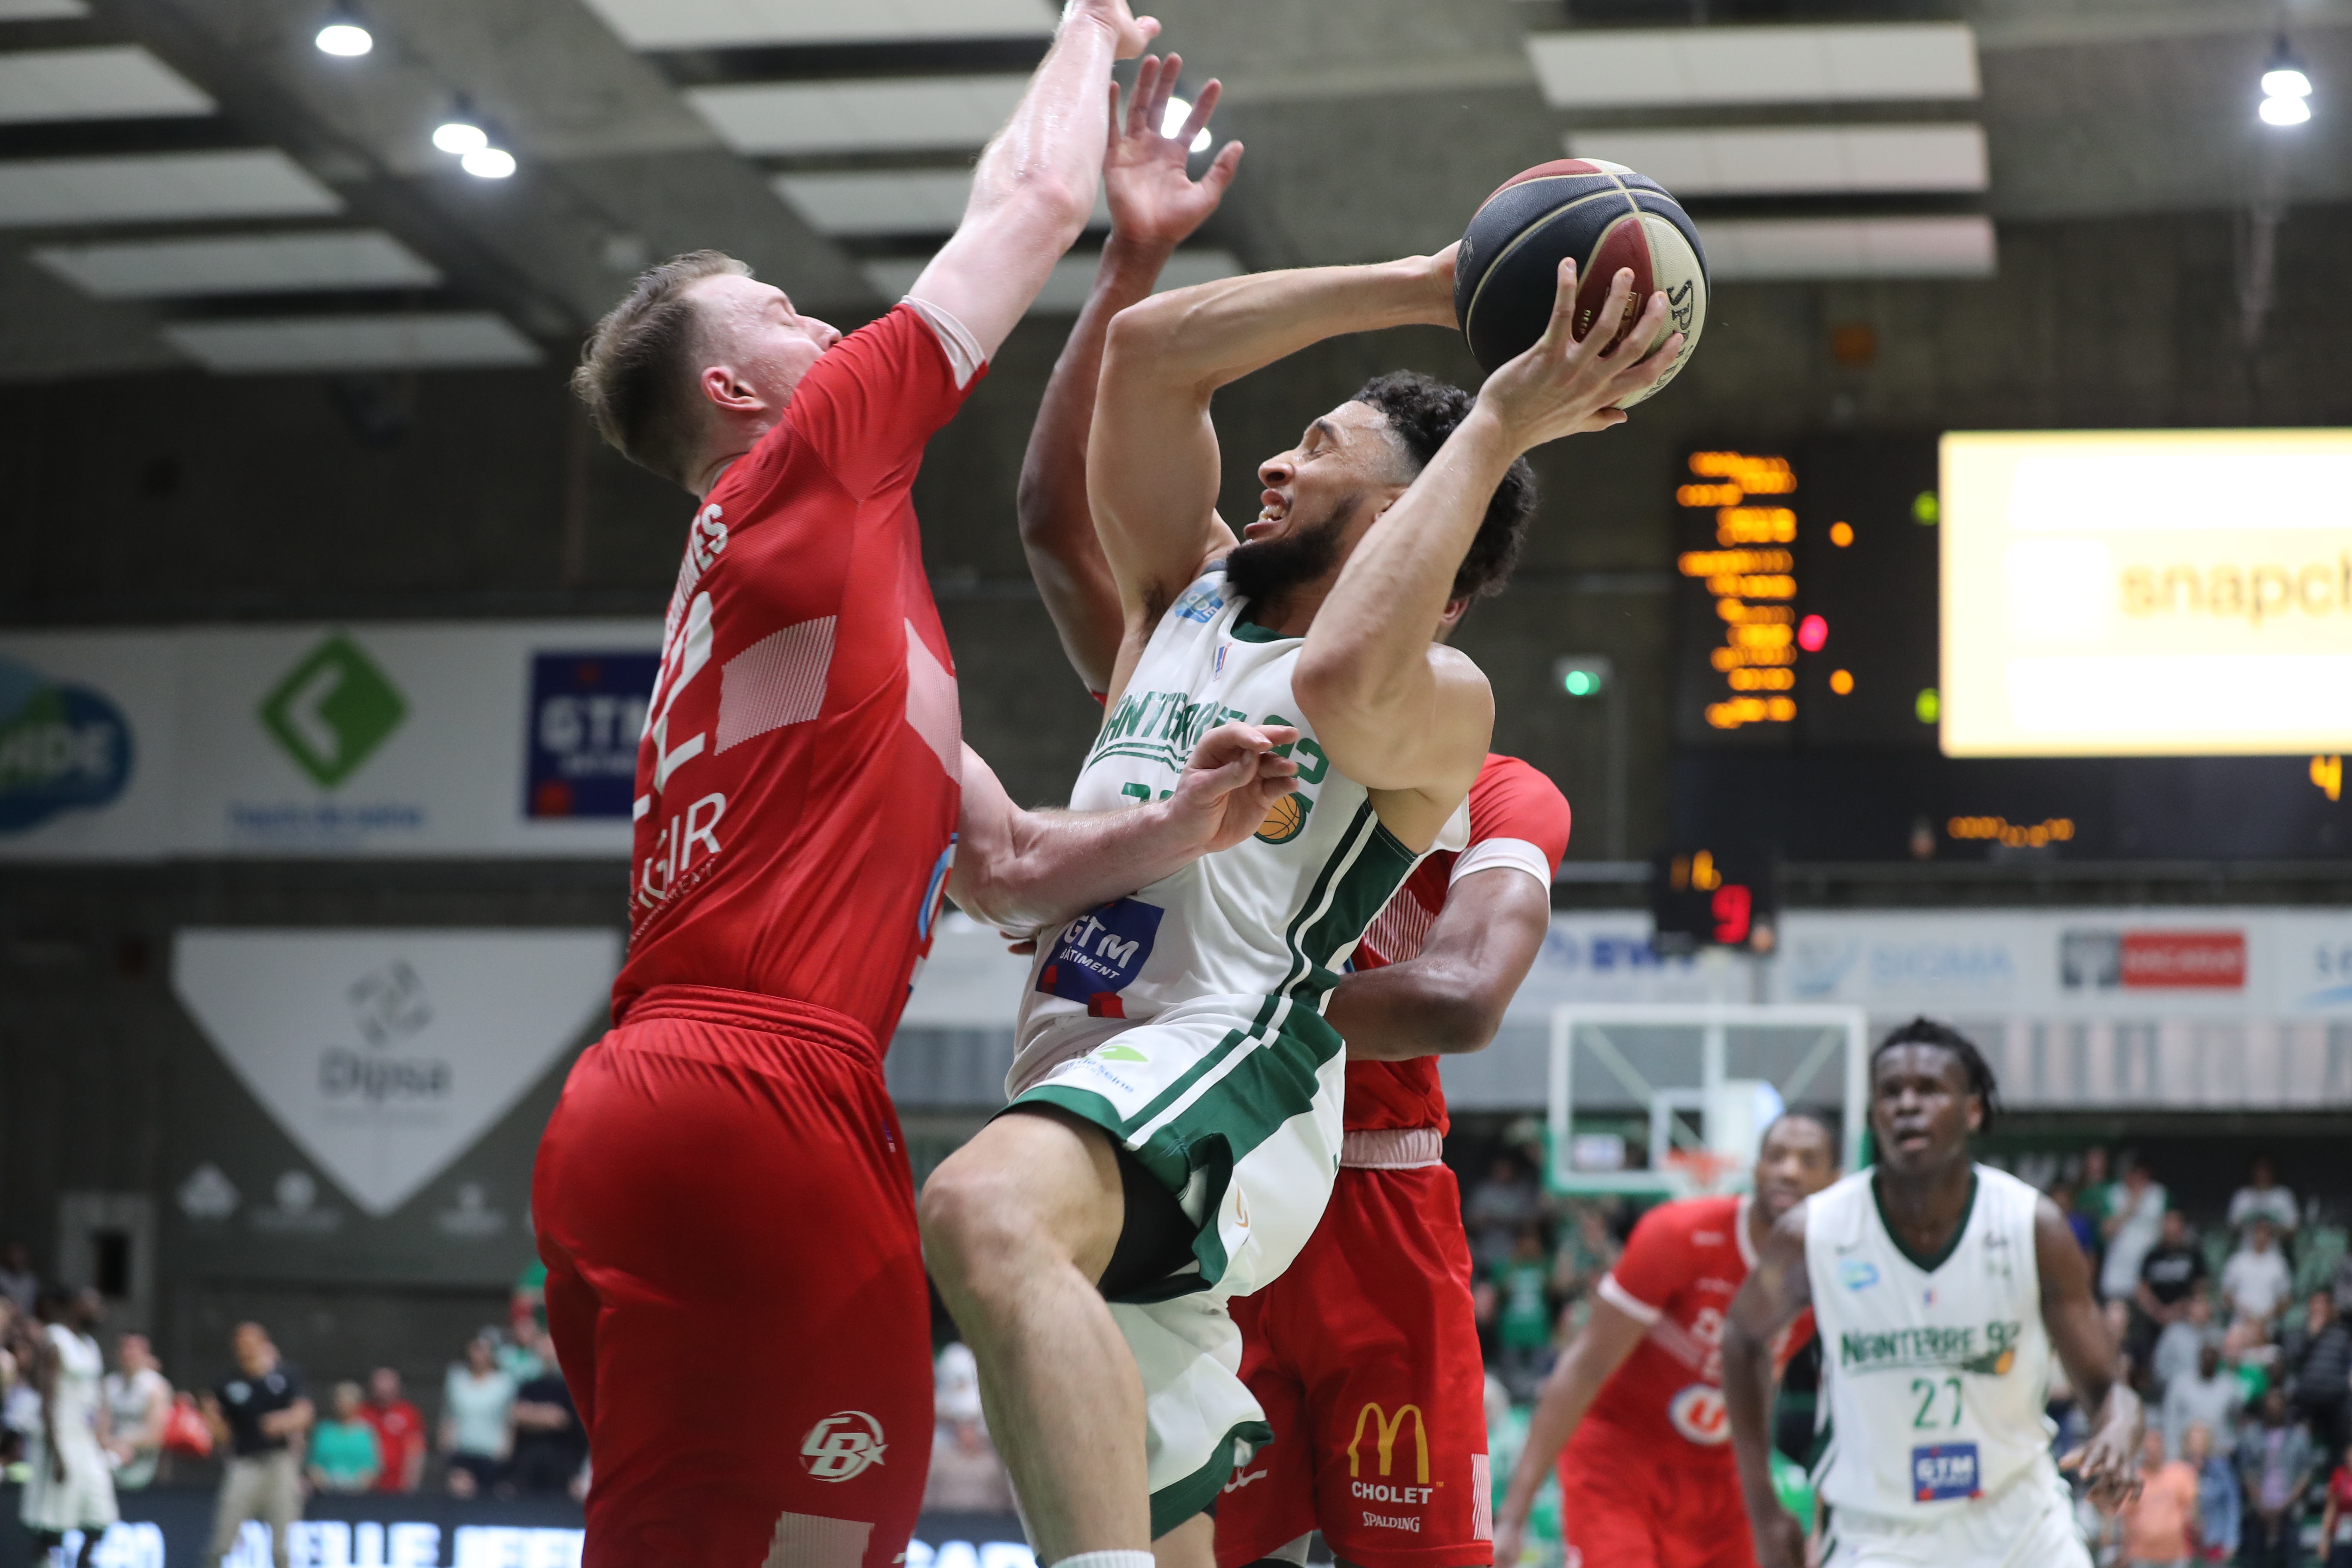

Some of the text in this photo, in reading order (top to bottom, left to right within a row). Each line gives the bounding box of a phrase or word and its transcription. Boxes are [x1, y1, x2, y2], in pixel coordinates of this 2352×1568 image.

[1064, 915, 1139, 969] GTM
[1911, 1376, 1963, 1428] 27
[1351, 1481, 1433, 1504] CHOLET
[1363, 1511, 1420, 1533] SPALDING
